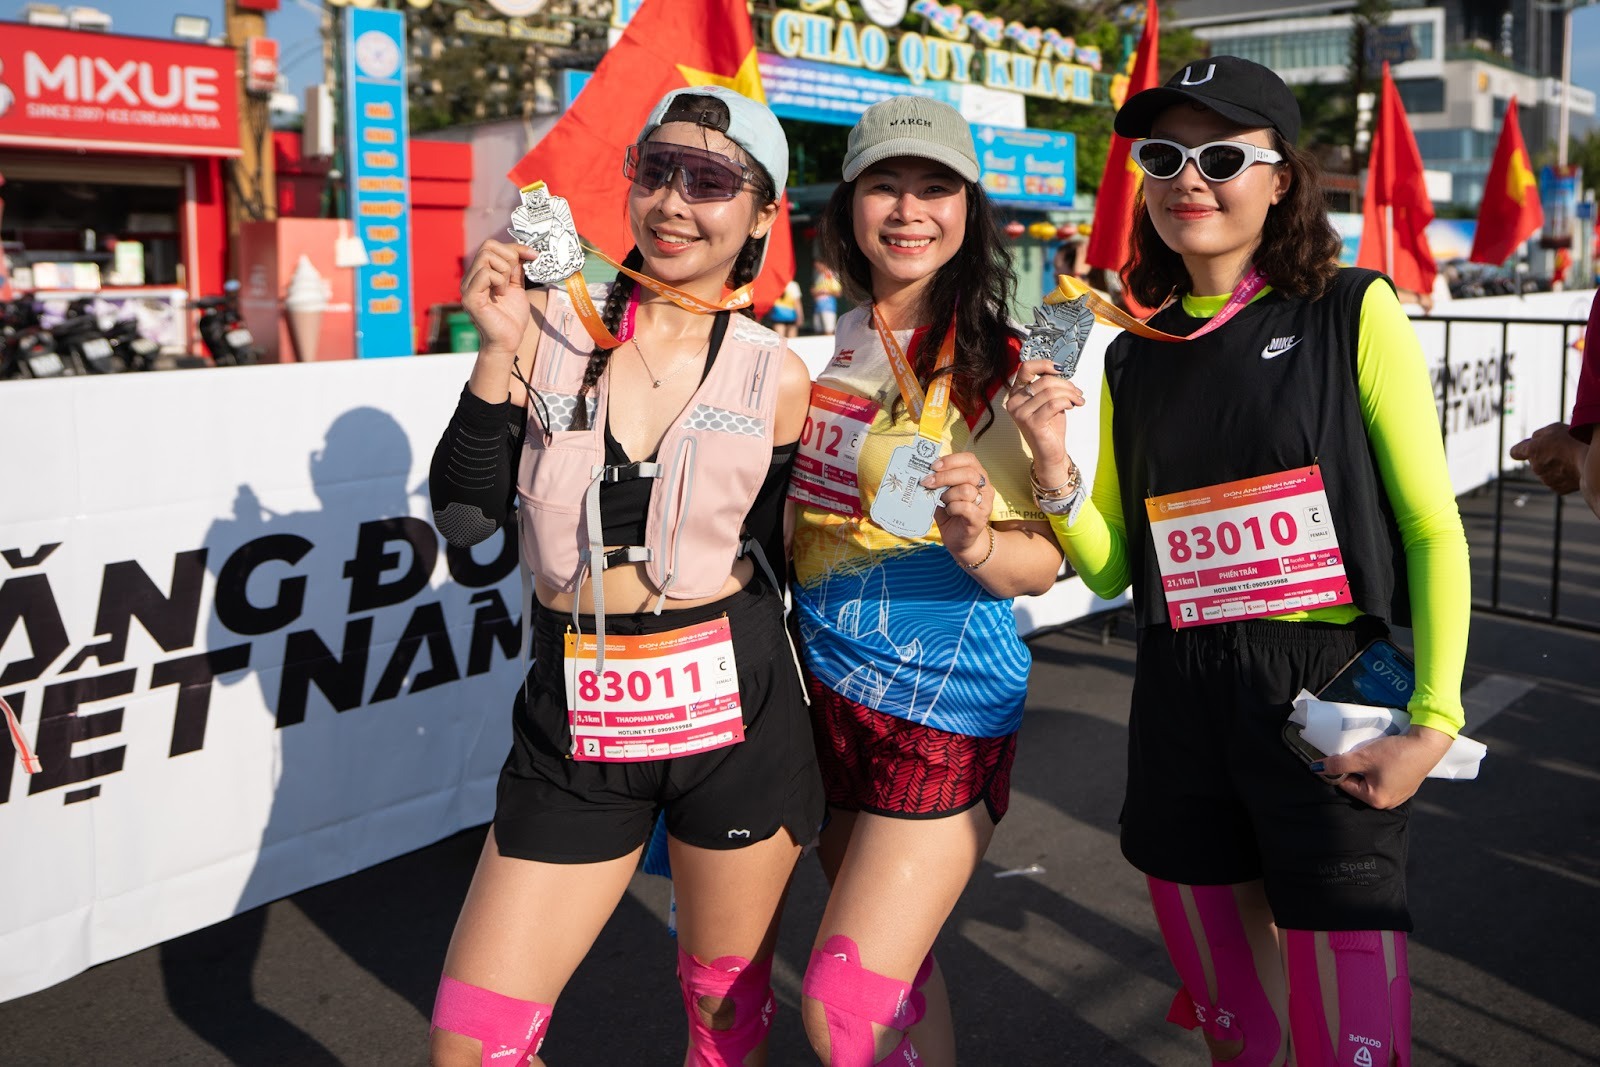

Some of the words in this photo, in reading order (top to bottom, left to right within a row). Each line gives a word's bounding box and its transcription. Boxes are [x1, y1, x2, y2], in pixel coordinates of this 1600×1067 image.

[23, 50, 221, 112] MIXUE
[890, 118, 932, 128] MARCH
[1269, 335, 1296, 350] NIKE
[851, 438, 858, 448] C
[902, 476, 917, 503] FINISHER
[1311, 512, 1321, 523] C
[1167, 511, 1298, 564] 83010
[1166, 577, 1195, 588] 21,1km
[1213, 583, 1237, 594] HOTLINE
[1186, 607, 1193, 617] 2
[719, 661, 727, 671] C
[578, 661, 702, 702] 83011
[1373, 660, 1408, 692] 07:10
[615, 713, 654, 724] THAOPHAM
[654, 712, 675, 721] YOGA
[589, 743, 595, 752] 2
[1340, 858, 1377, 873] Speed
[1348, 1033, 1382, 1049] GOTAPE
